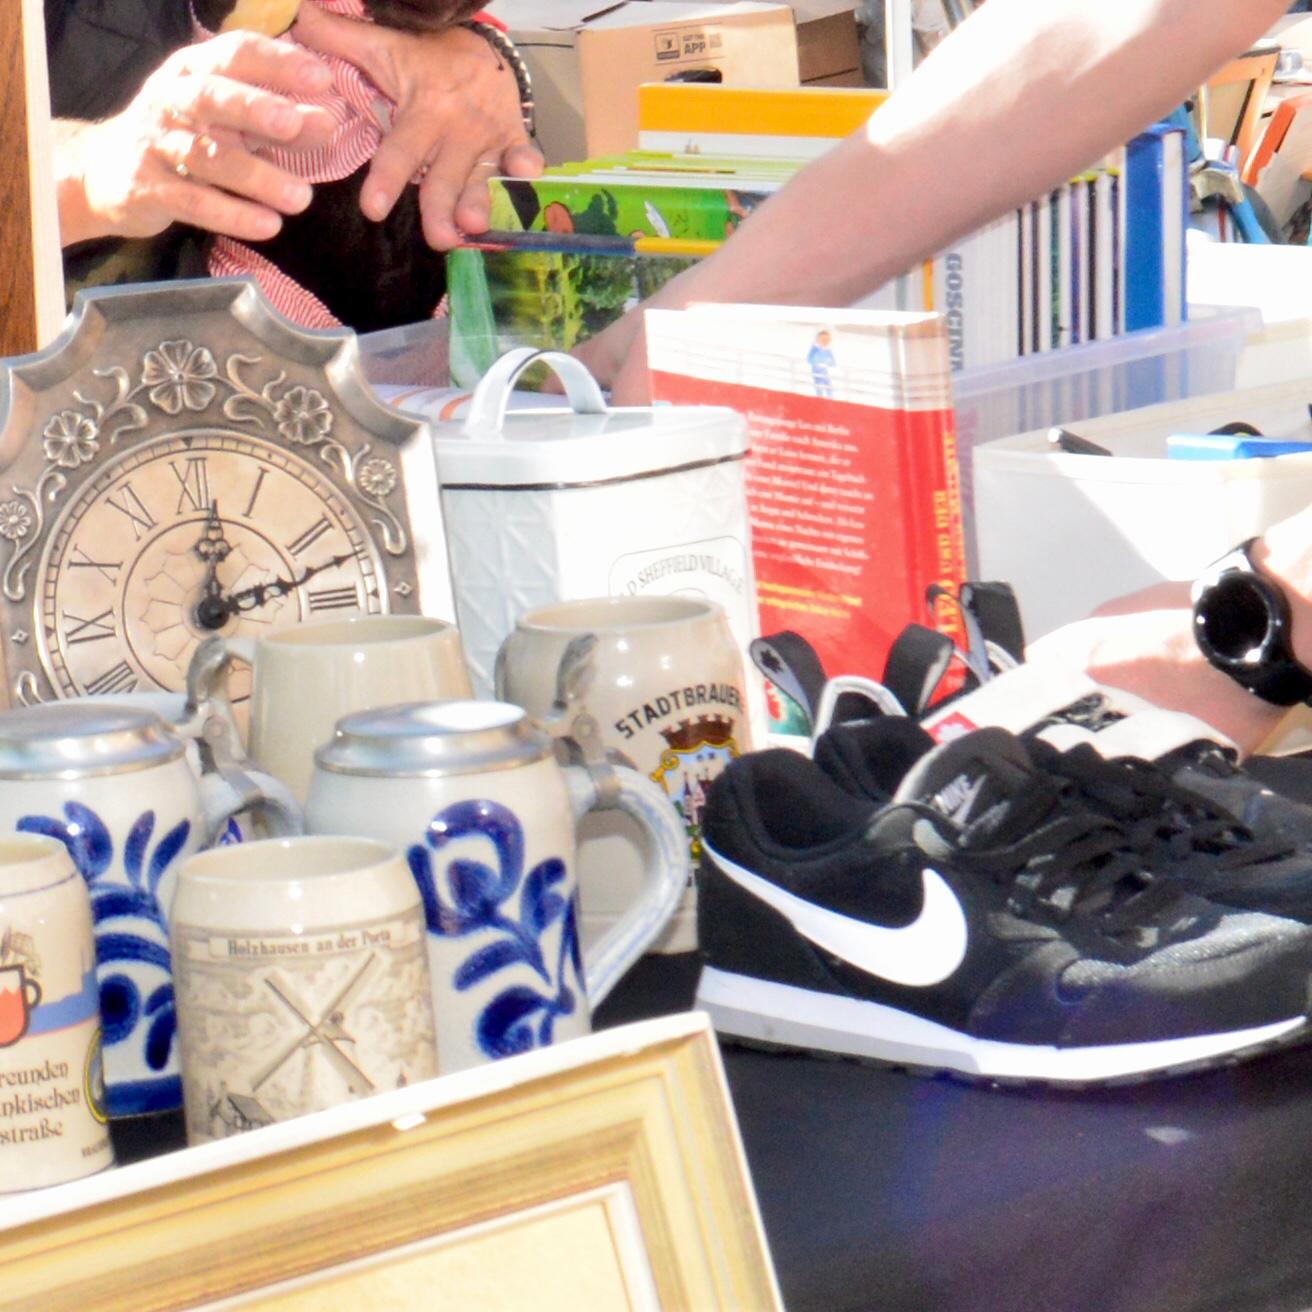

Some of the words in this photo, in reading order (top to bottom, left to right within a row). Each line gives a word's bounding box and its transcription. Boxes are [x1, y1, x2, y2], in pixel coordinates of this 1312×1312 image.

[228, 939, 310, 956] Holzhausen
[316, 940, 333, 953] an
[336, 934, 357, 950] der
